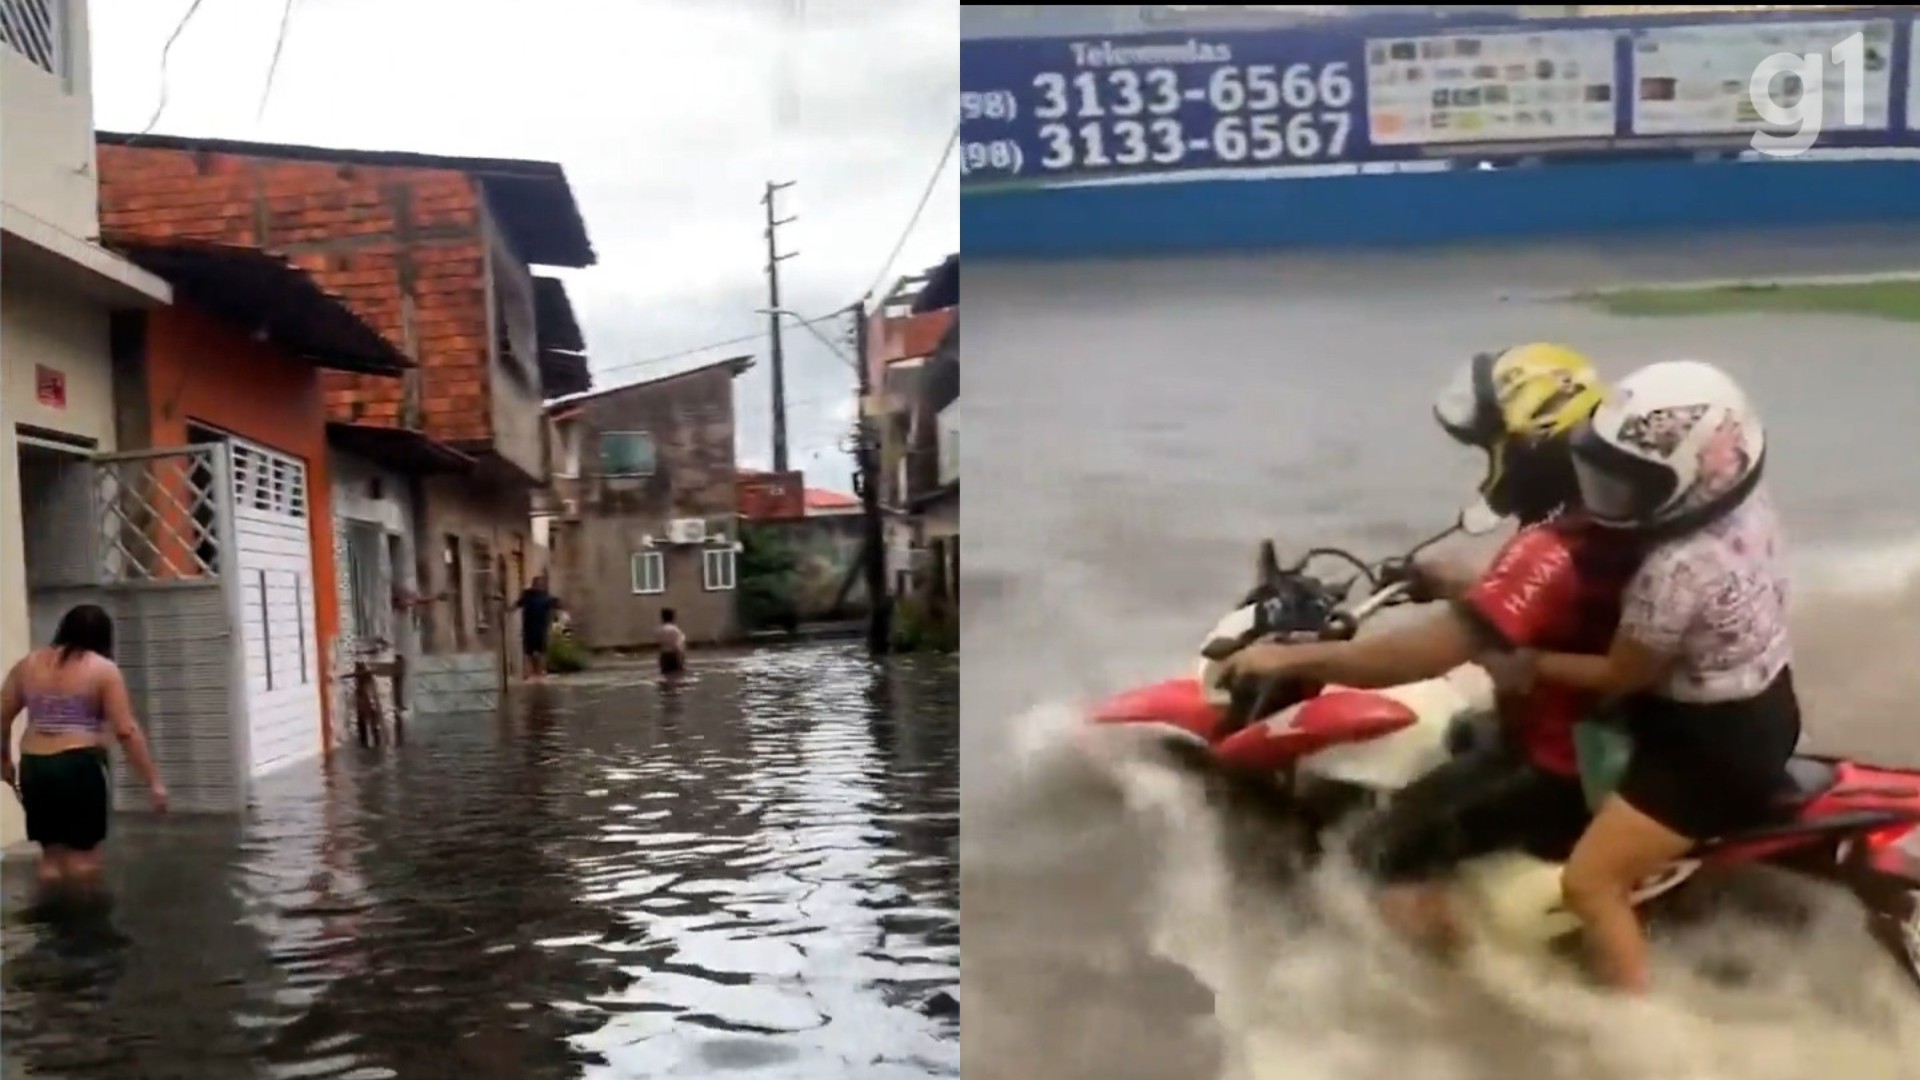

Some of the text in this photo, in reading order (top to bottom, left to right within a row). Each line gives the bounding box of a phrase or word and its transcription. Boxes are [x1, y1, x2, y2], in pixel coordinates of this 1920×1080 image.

[1070, 39, 1232, 67] Teldas
[960, 62, 1352, 122] 98) 3133-6566
[1040, 112, 1352, 169] 3133-6567
[1503, 544, 1570, 615] HAVAN
